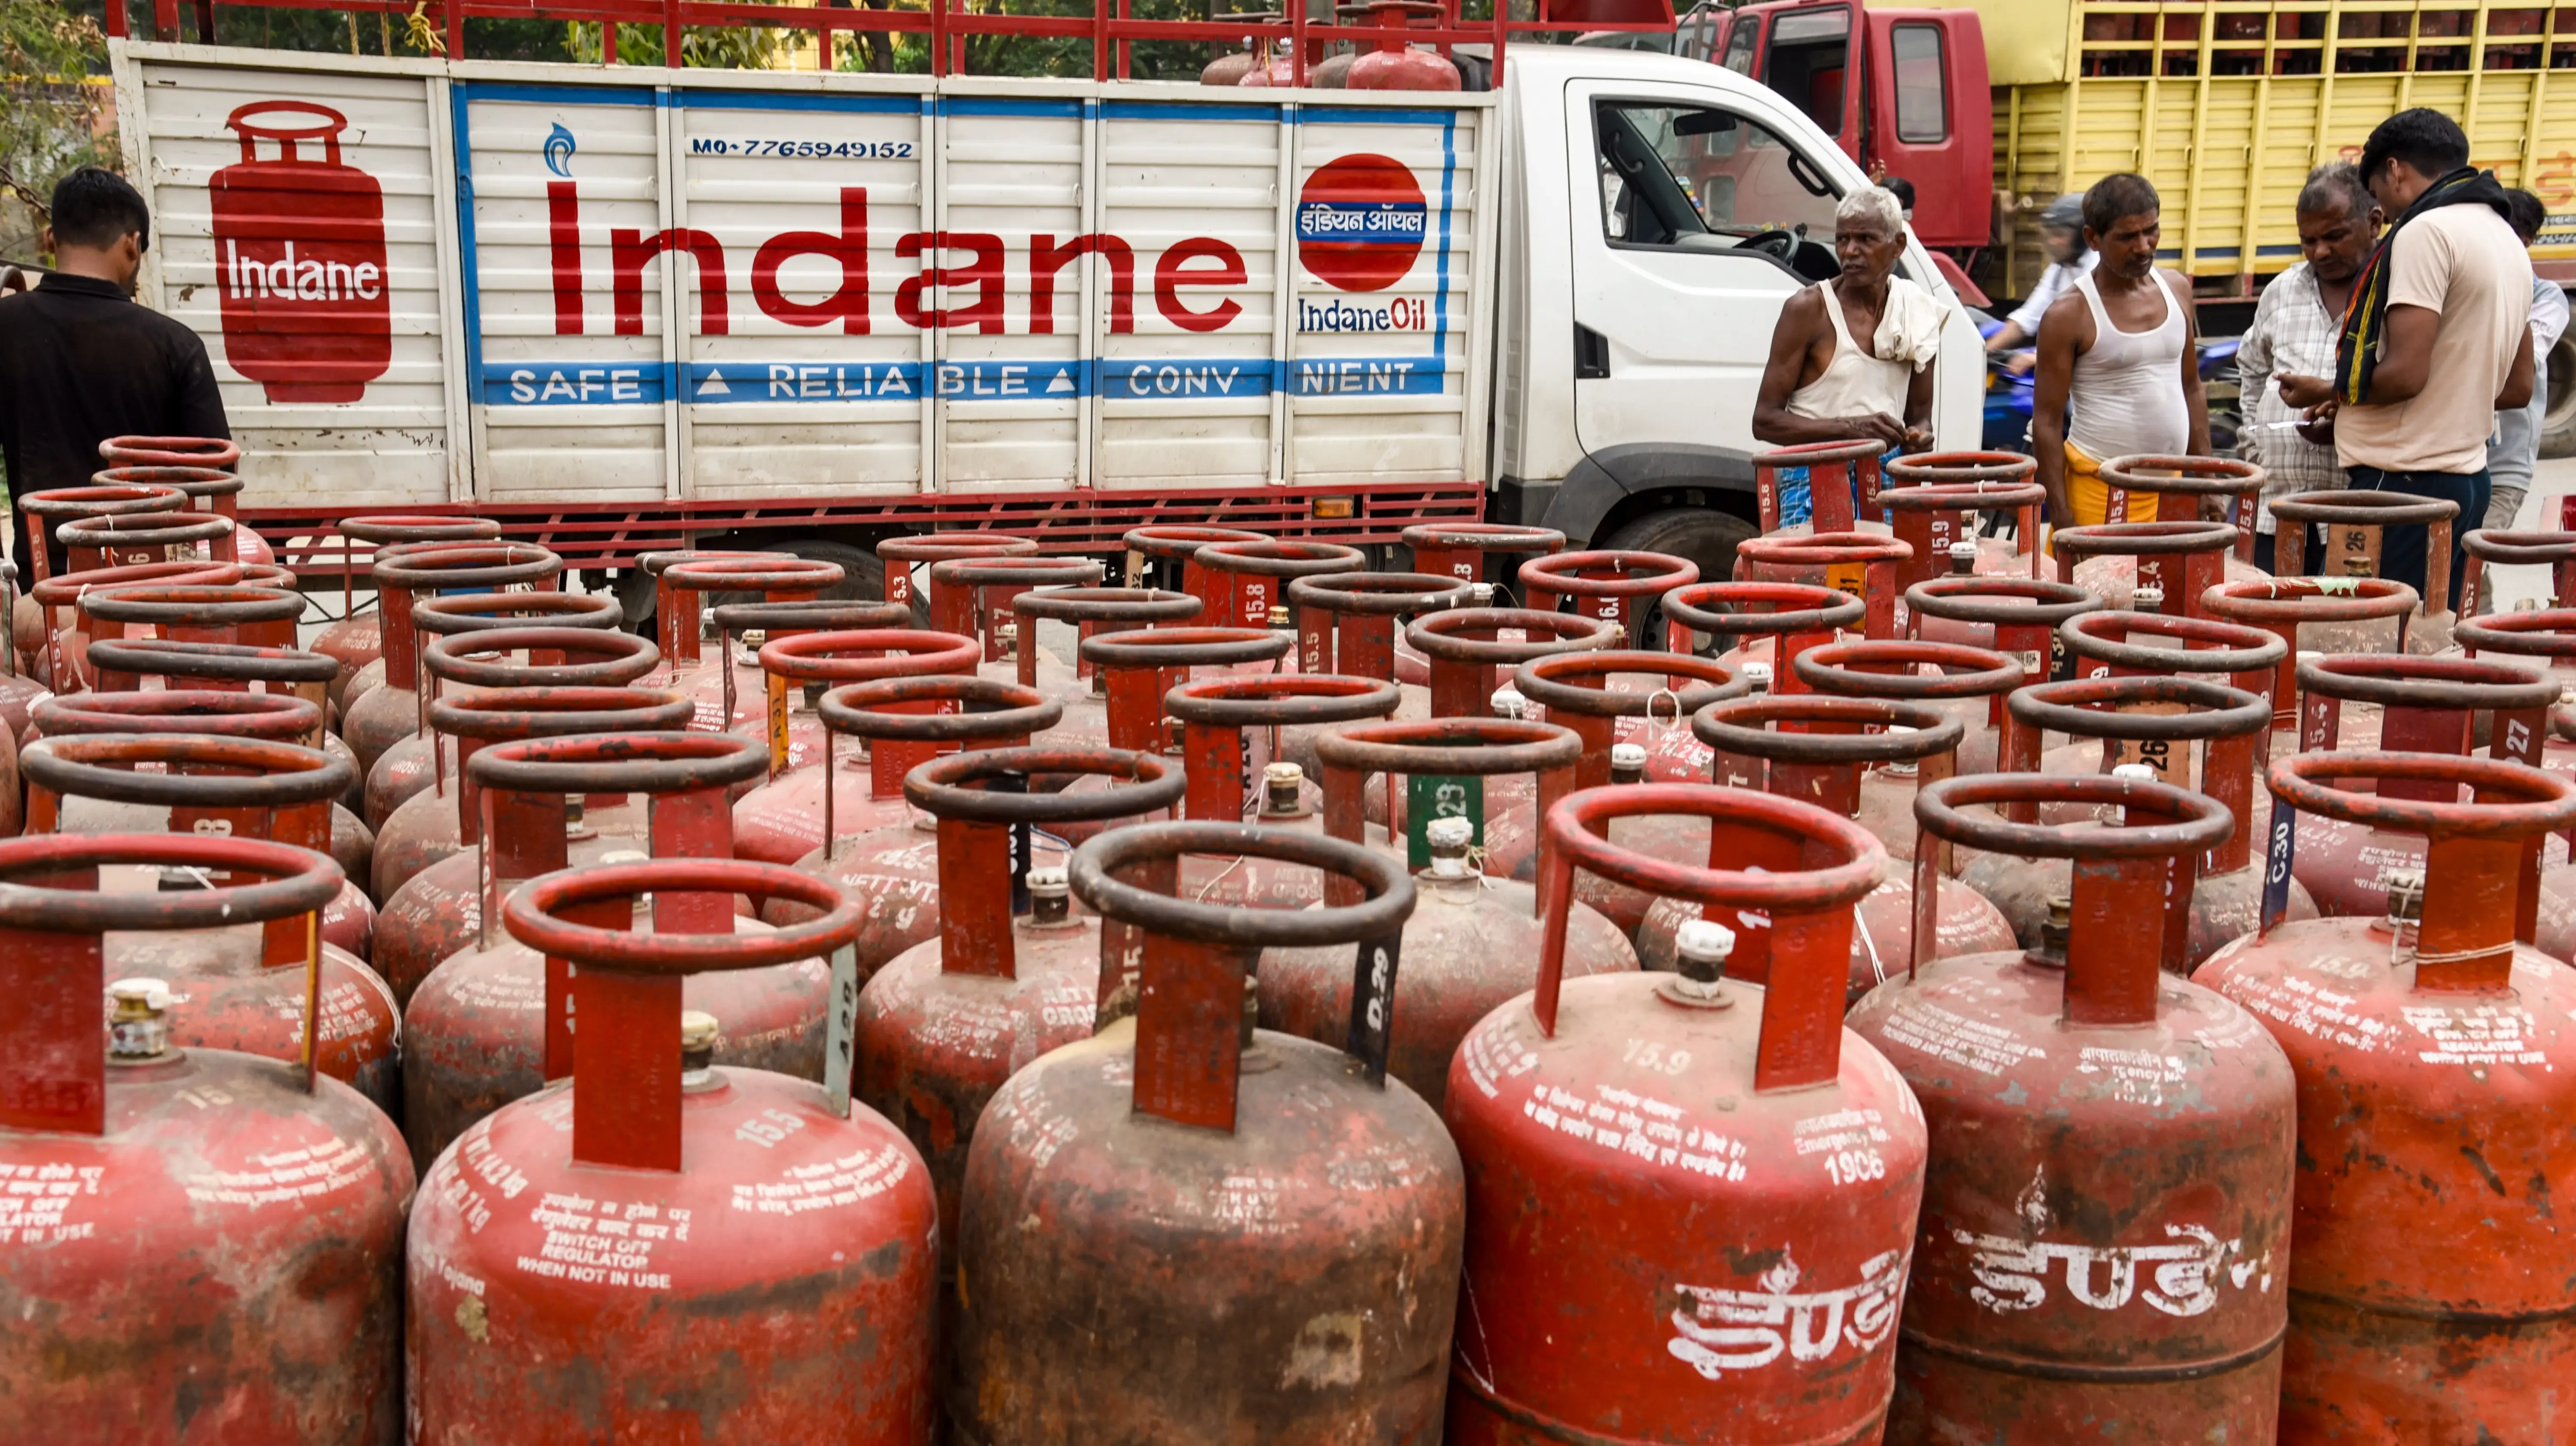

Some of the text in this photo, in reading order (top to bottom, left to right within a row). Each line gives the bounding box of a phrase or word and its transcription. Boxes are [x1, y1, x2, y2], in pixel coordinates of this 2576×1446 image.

[1301, 203, 1425, 234] इंडियन ऑयल
[227, 239, 380, 301] Indane
[510, 369, 641, 404] SAFE
[1761, 484, 1771, 515] 15.8
[2110, 489, 2125, 524] 15.5
[2239, 498, 2253, 536] 15.5
[2345, 531, 2367, 552] 26
[1246, 584, 1265, 622] 15.8
[51, 628, 62, 670] 15.5
[1306, 632, 1319, 675] 15.5
[2139, 740, 2169, 772] 26
[1623, 1038, 1692, 1075] 15.9
[735, 1108, 806, 1149] 15.5
[499, 1168, 529, 1199] kg
[53, 1221, 95, 1241] USE
[668, 1208, 691, 1221] पर
[541, 1243, 649, 1270] REGULATOR
[545, 1230, 652, 1255] SWITCH OFF
[516, 1255, 672, 1289] WHEN NOT IN USE
